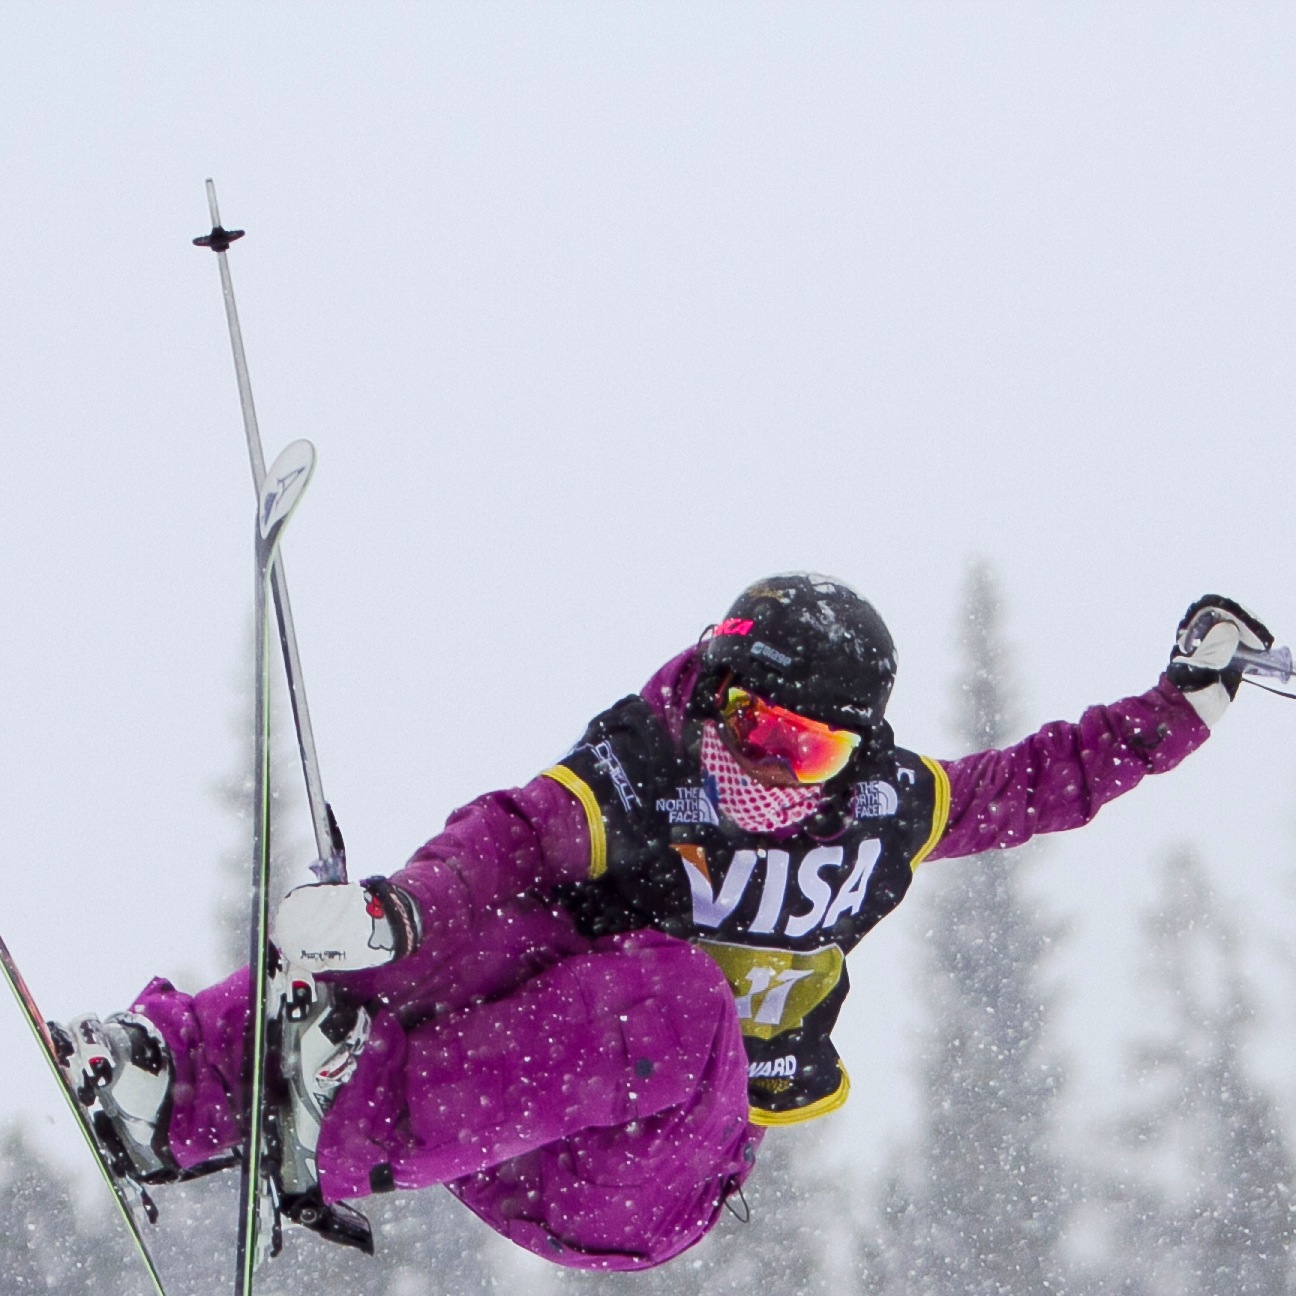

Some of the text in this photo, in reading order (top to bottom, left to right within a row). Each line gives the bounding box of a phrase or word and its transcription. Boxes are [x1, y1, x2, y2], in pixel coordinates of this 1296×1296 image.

[676, 787, 698, 799] THE
[656, 799, 698, 812] NORTH
[855, 794, 879, 806] RTH
[669, 811, 698, 824] FACE
[855, 805, 879, 818] FACE
[669, 838, 882, 938] VISA
